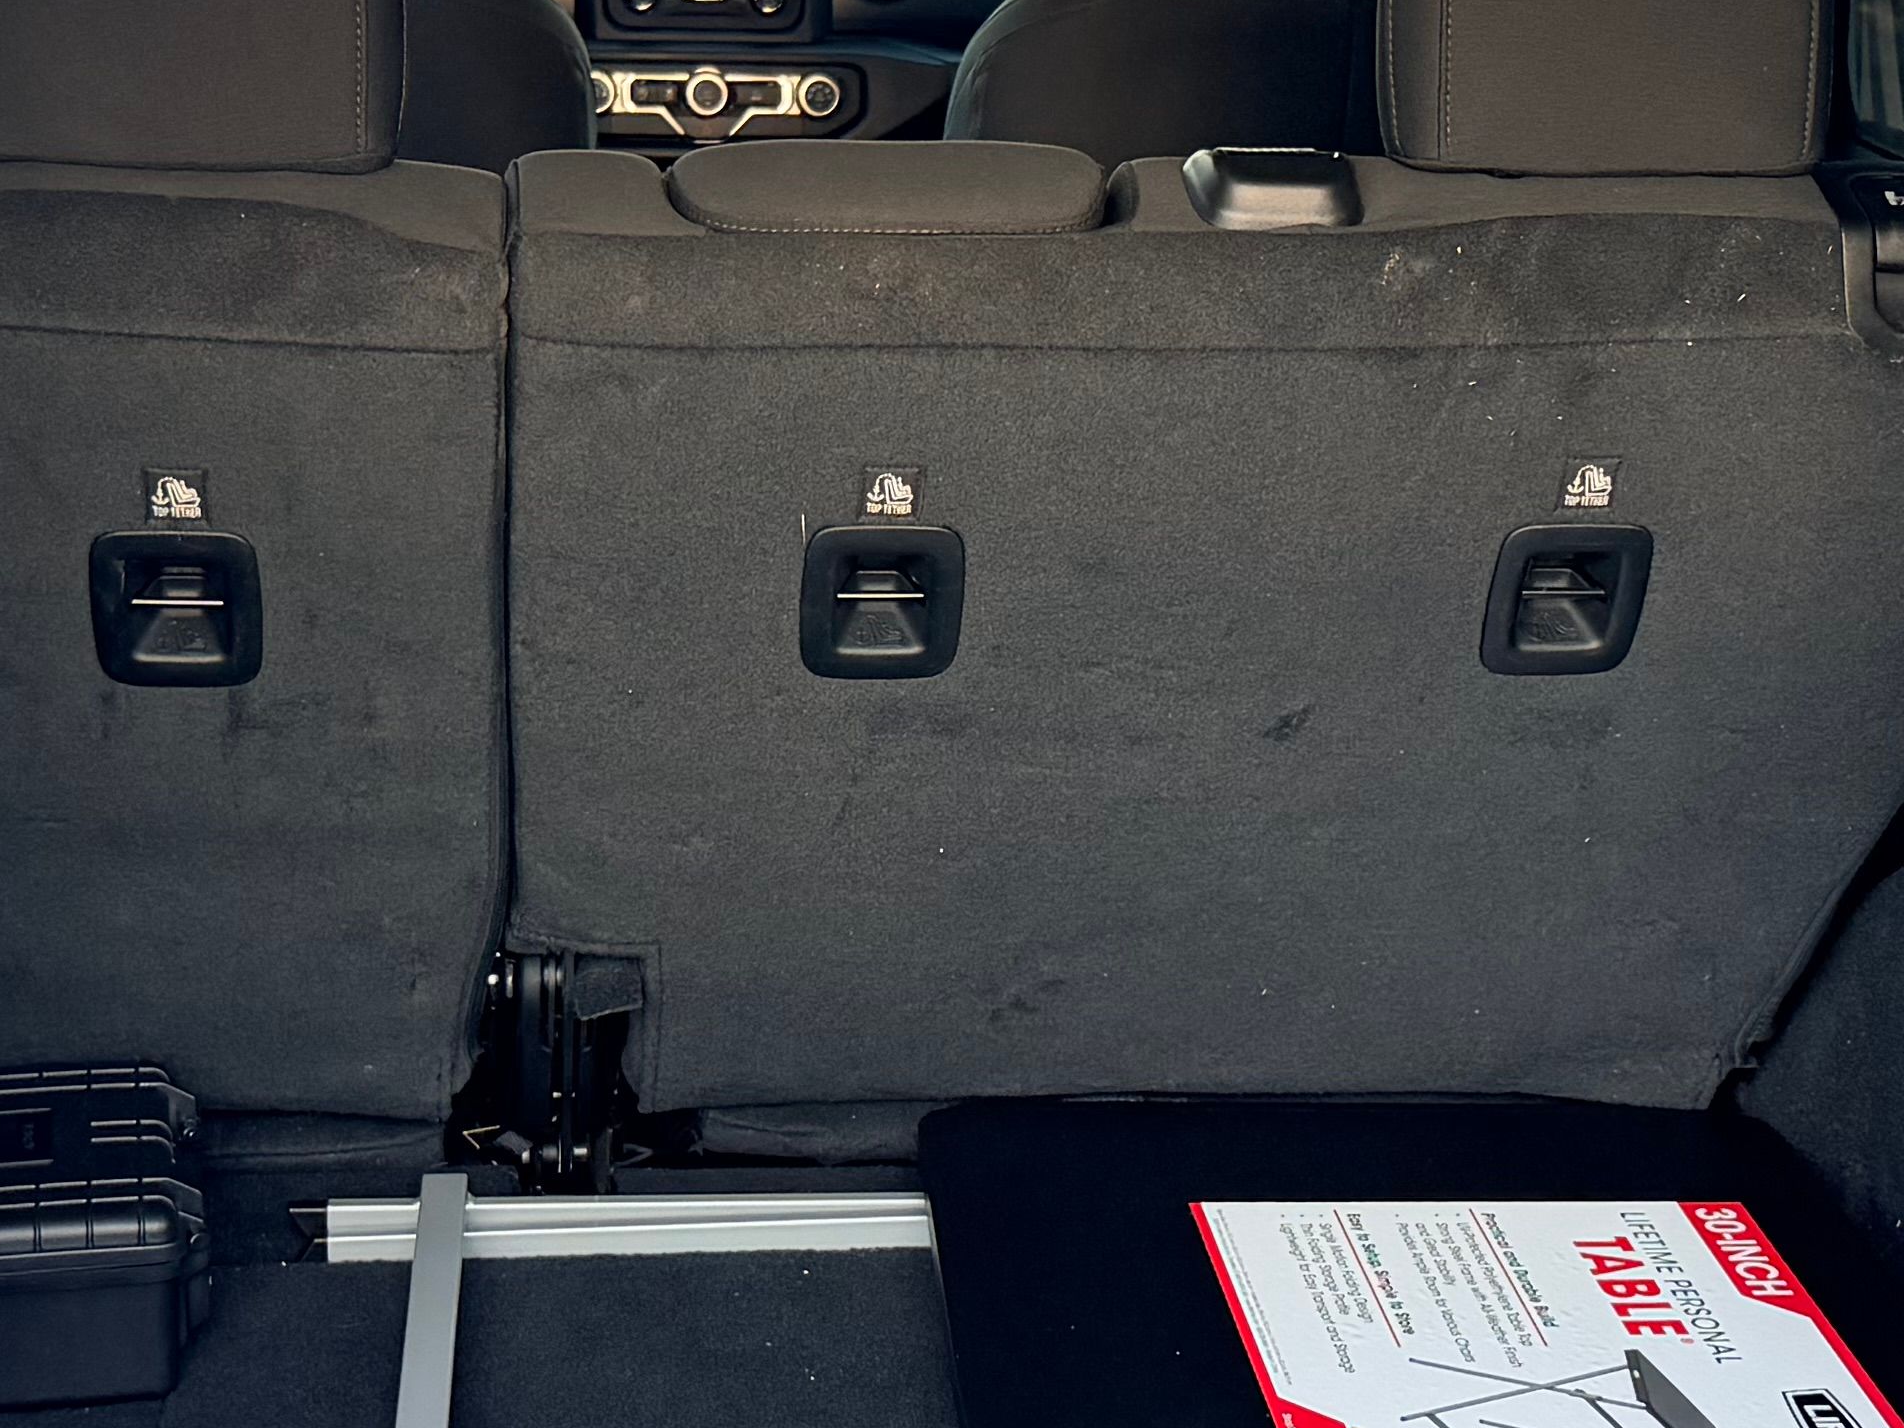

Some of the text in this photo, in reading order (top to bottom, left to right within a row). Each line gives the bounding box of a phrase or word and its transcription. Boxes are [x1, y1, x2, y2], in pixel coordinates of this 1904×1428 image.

[866, 502, 912, 515] TOP TETHER
[1565, 494, 1609, 507] TOP TETHER
[152, 505, 201, 518] TOP TETHER
[1343, 1213, 1368, 1230] Easy
[1414, 1222, 1432, 1236] and
[1355, 1233, 1373, 1241] to
[1690, 1207, 1796, 1296] 30-INCH
[1480, 1213, 1559, 1327] Practical and Durable Build
[1370, 1270, 1402, 1299] Simple
[1618, 1211, 1746, 1363] LIFETIME PERSONAL
[1388, 1301, 1406, 1309] to
[1393, 1312, 1419, 1334] Store
[1324, 1326, 1344, 1341] and
[1329, 1343, 1359, 1373] Storage
